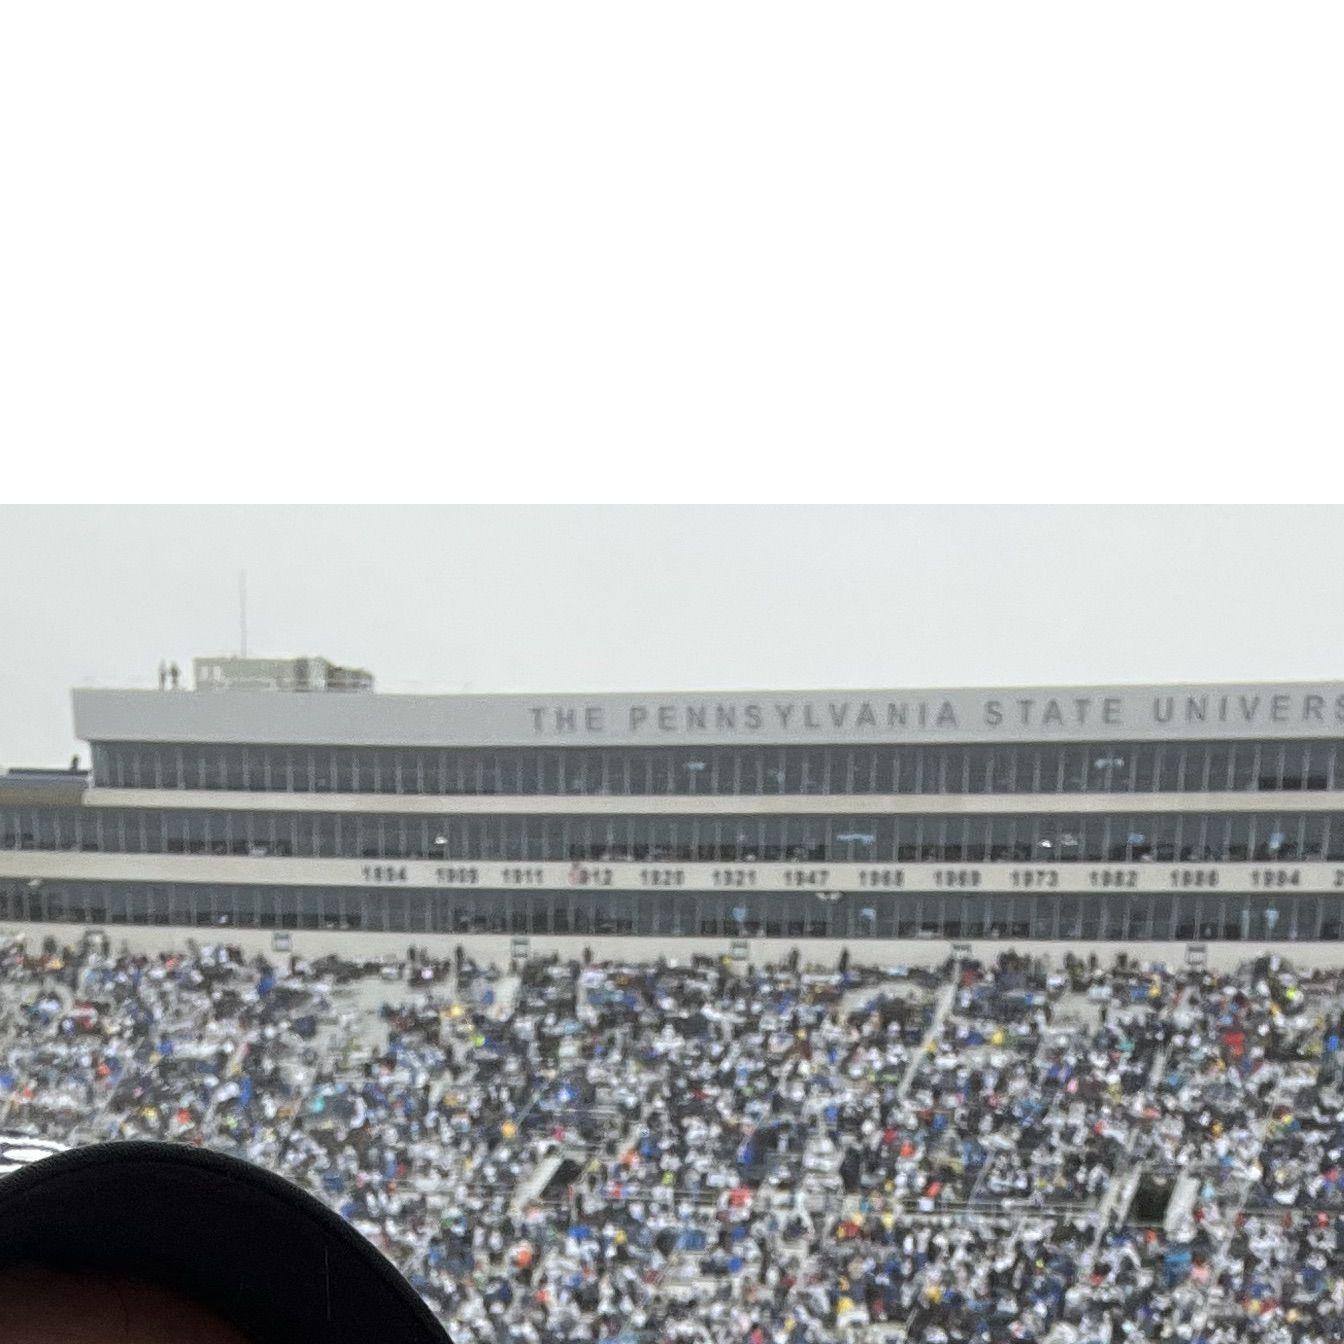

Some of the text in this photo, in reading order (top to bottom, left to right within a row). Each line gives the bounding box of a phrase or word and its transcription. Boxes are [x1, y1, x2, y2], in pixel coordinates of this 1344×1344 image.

[528, 706, 605, 732] THE
[628, 699, 959, 732] PENNSYLVANIA
[982, 697, 1124, 728] STATE
[570, 868, 614, 886] 912
[783, 870, 831, 886] 1947
[1011, 869, 1059, 888] 1973
[1251, 869, 1301, 887] 1994
